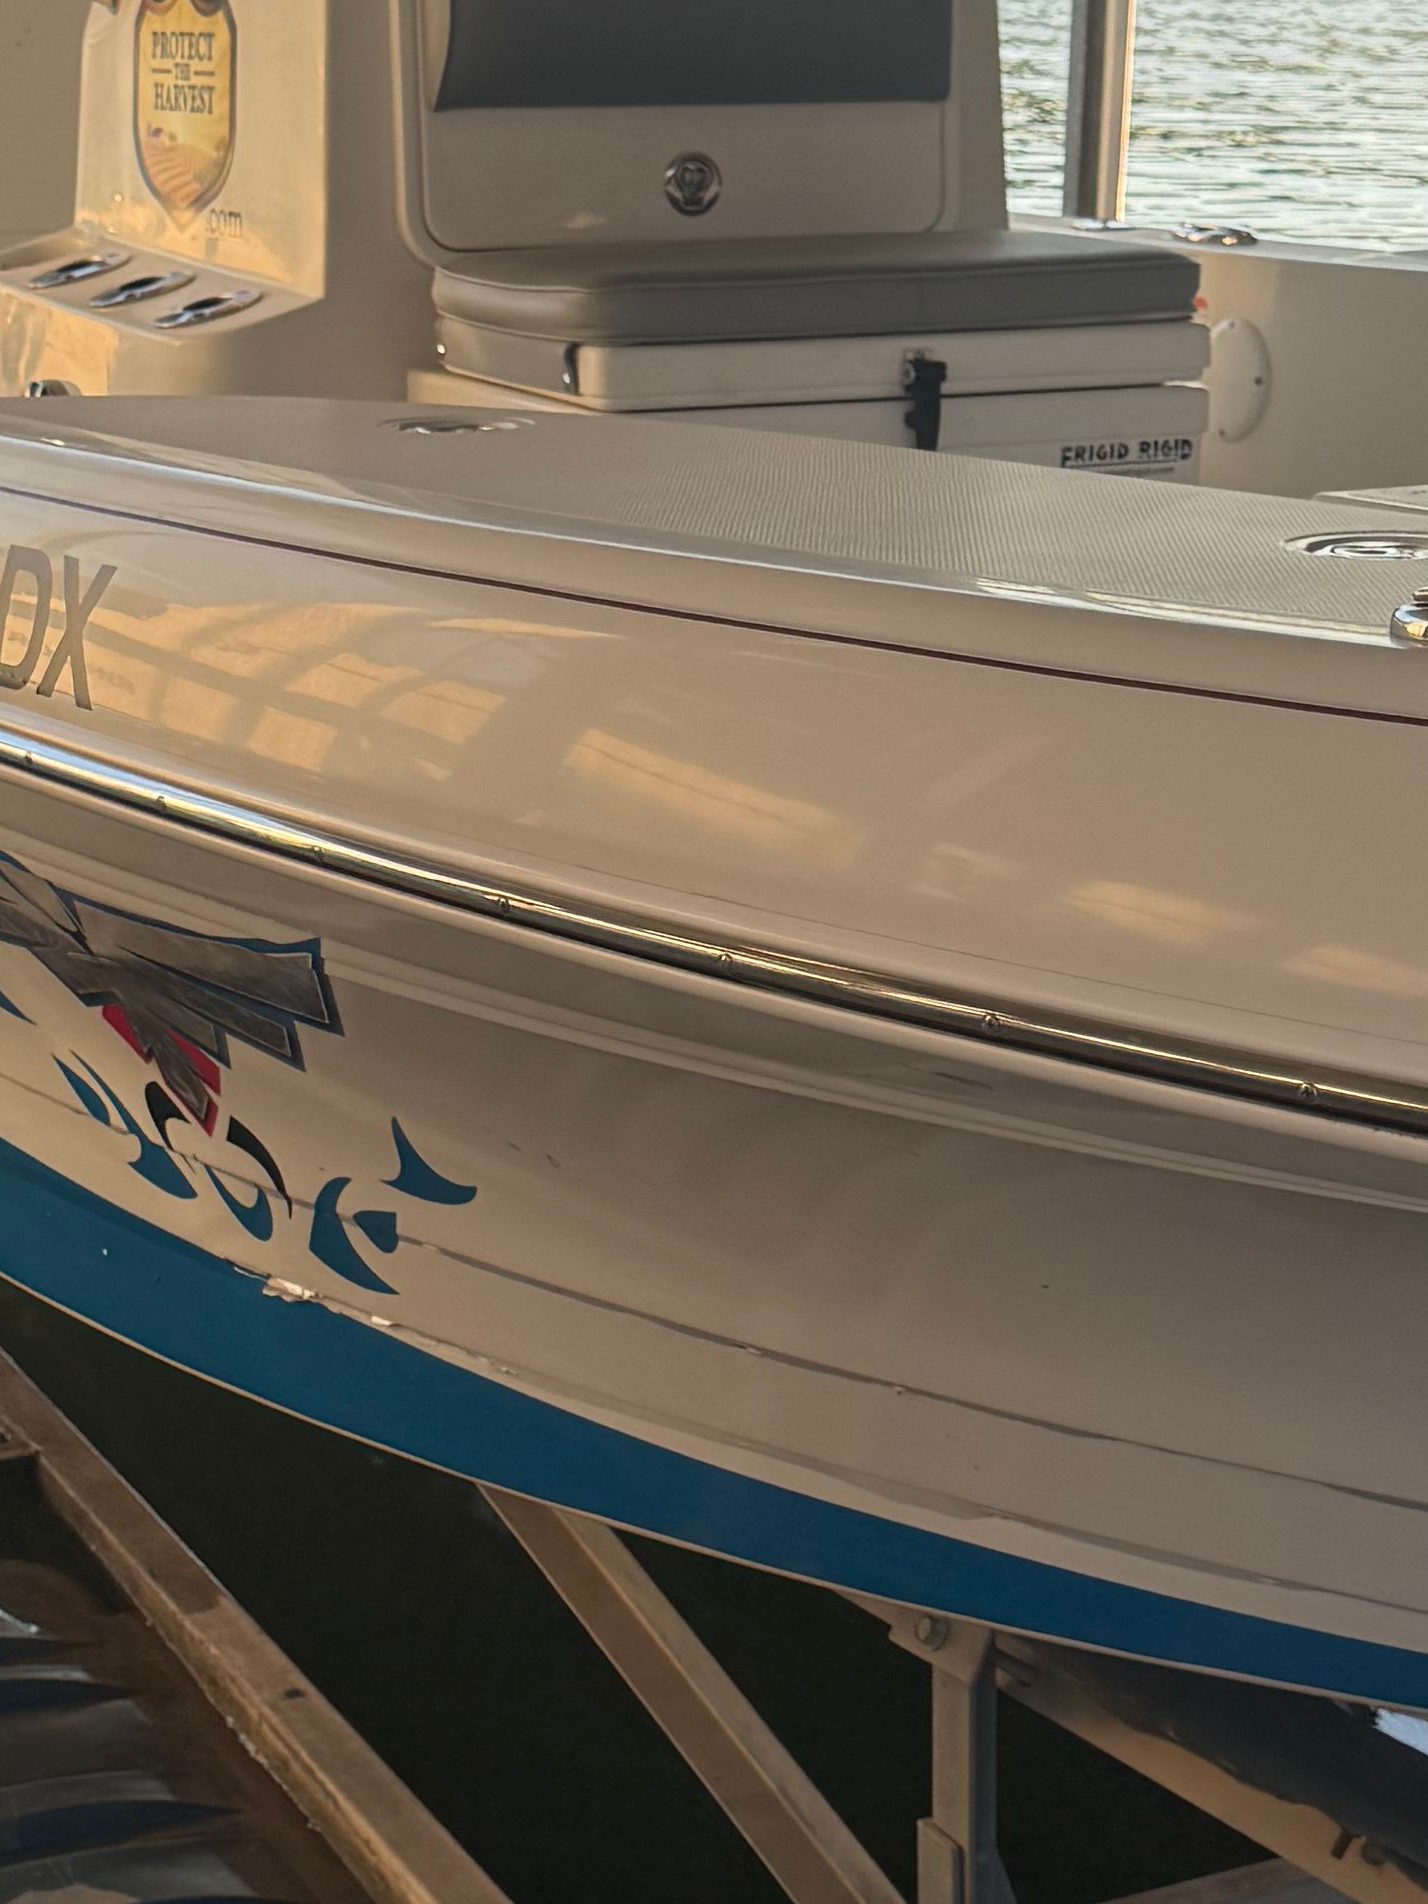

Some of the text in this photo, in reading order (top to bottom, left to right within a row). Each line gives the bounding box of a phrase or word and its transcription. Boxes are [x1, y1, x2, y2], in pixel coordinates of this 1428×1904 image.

[151, 30, 215, 62] PROTECT
[173, 62, 191, 81] THE
[154, 82, 215, 114] HARVEST
[1060, 438, 1194, 468] FRIGID RIGID
